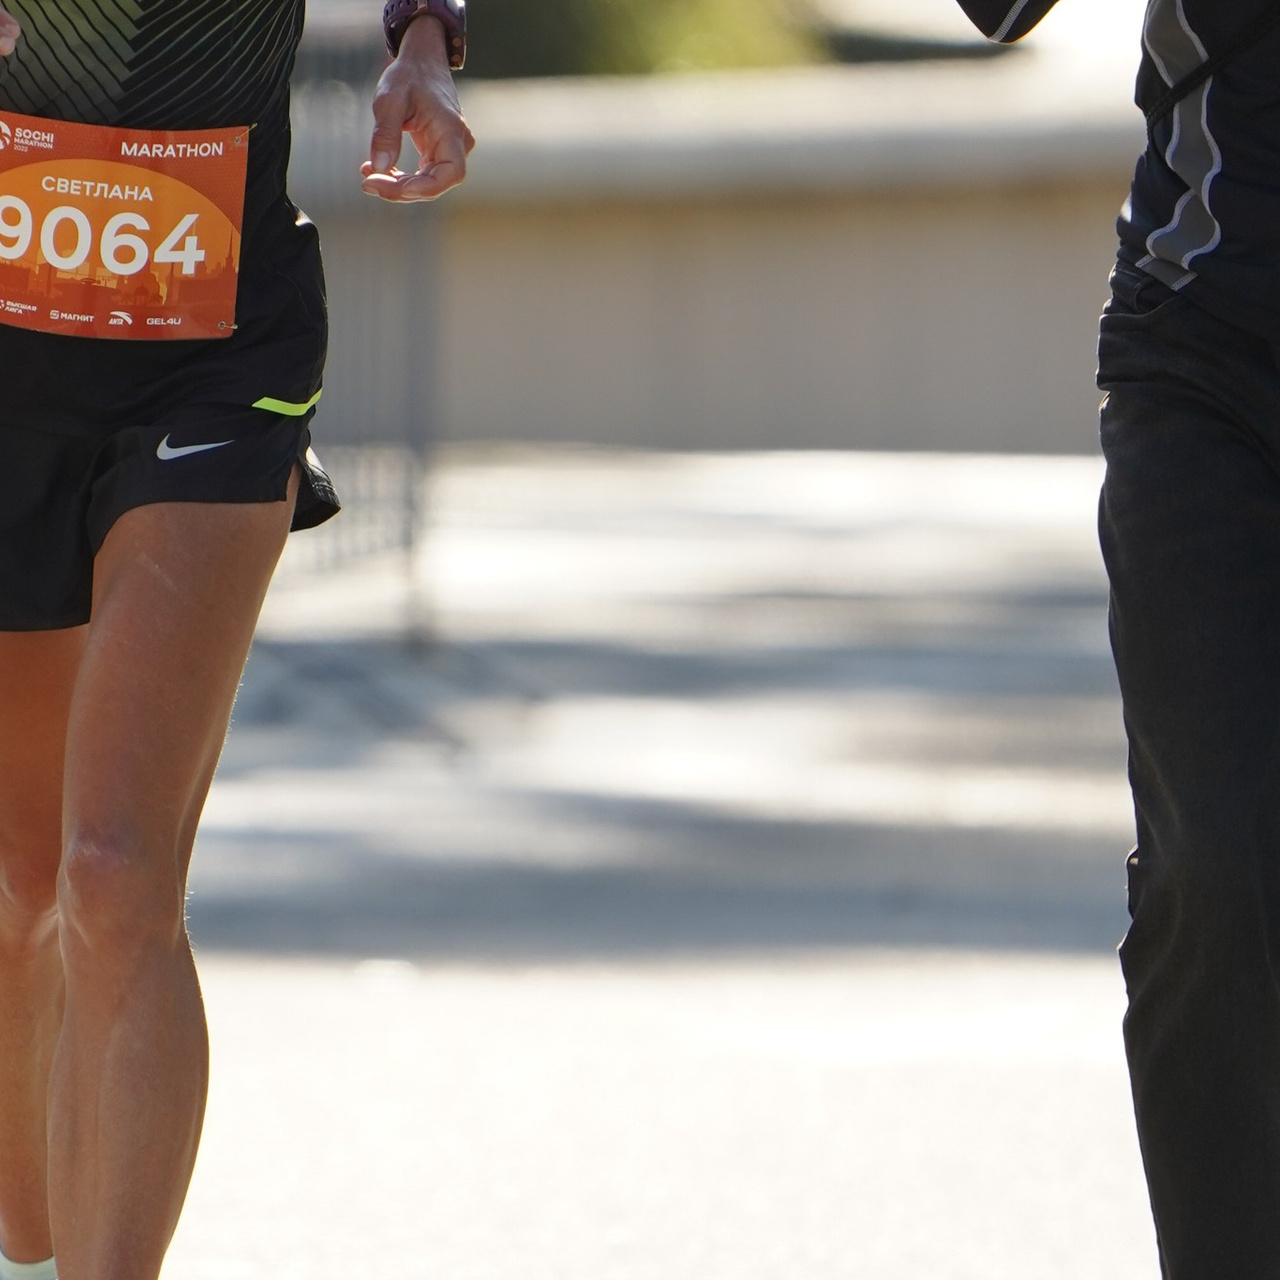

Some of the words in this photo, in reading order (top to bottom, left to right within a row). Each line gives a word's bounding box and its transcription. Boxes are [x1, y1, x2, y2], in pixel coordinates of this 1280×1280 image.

[15, 127, 54, 142] SOCHI
[14, 137, 53, 149] MARATHON
[121, 141, 223, 158] MARATHON
[41, 176, 153, 201] СВЕТЛАНА
[60, 312, 94, 322] МАГНИТ
